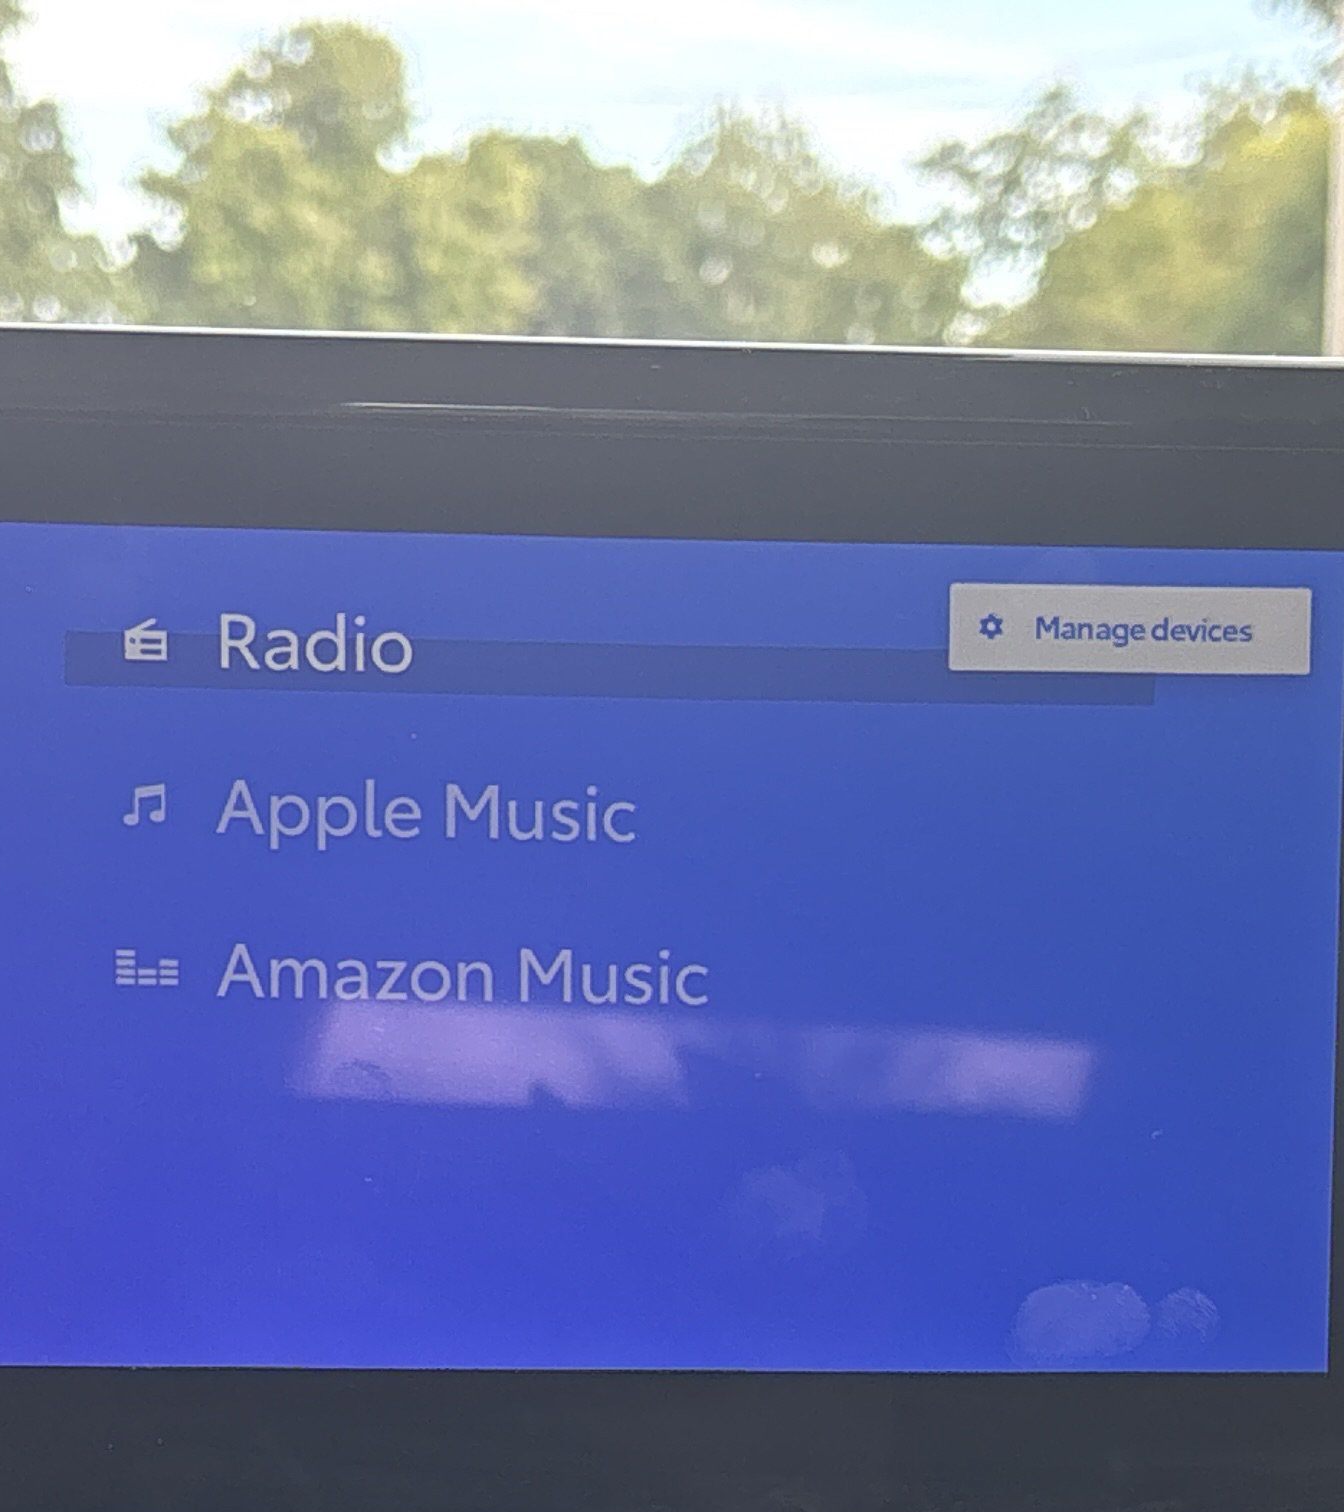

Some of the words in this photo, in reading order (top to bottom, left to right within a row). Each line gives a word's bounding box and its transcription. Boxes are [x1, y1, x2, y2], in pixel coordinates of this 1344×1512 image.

[217, 613, 414, 674] Radio
[1035, 616, 1145, 647] Manage
[1151, 618, 1253, 642] devices
[216, 779, 422, 850] Apple
[444, 785, 637, 843] Music
[216, 943, 495, 1001] Amazon
[520, 948, 709, 1006] Music
